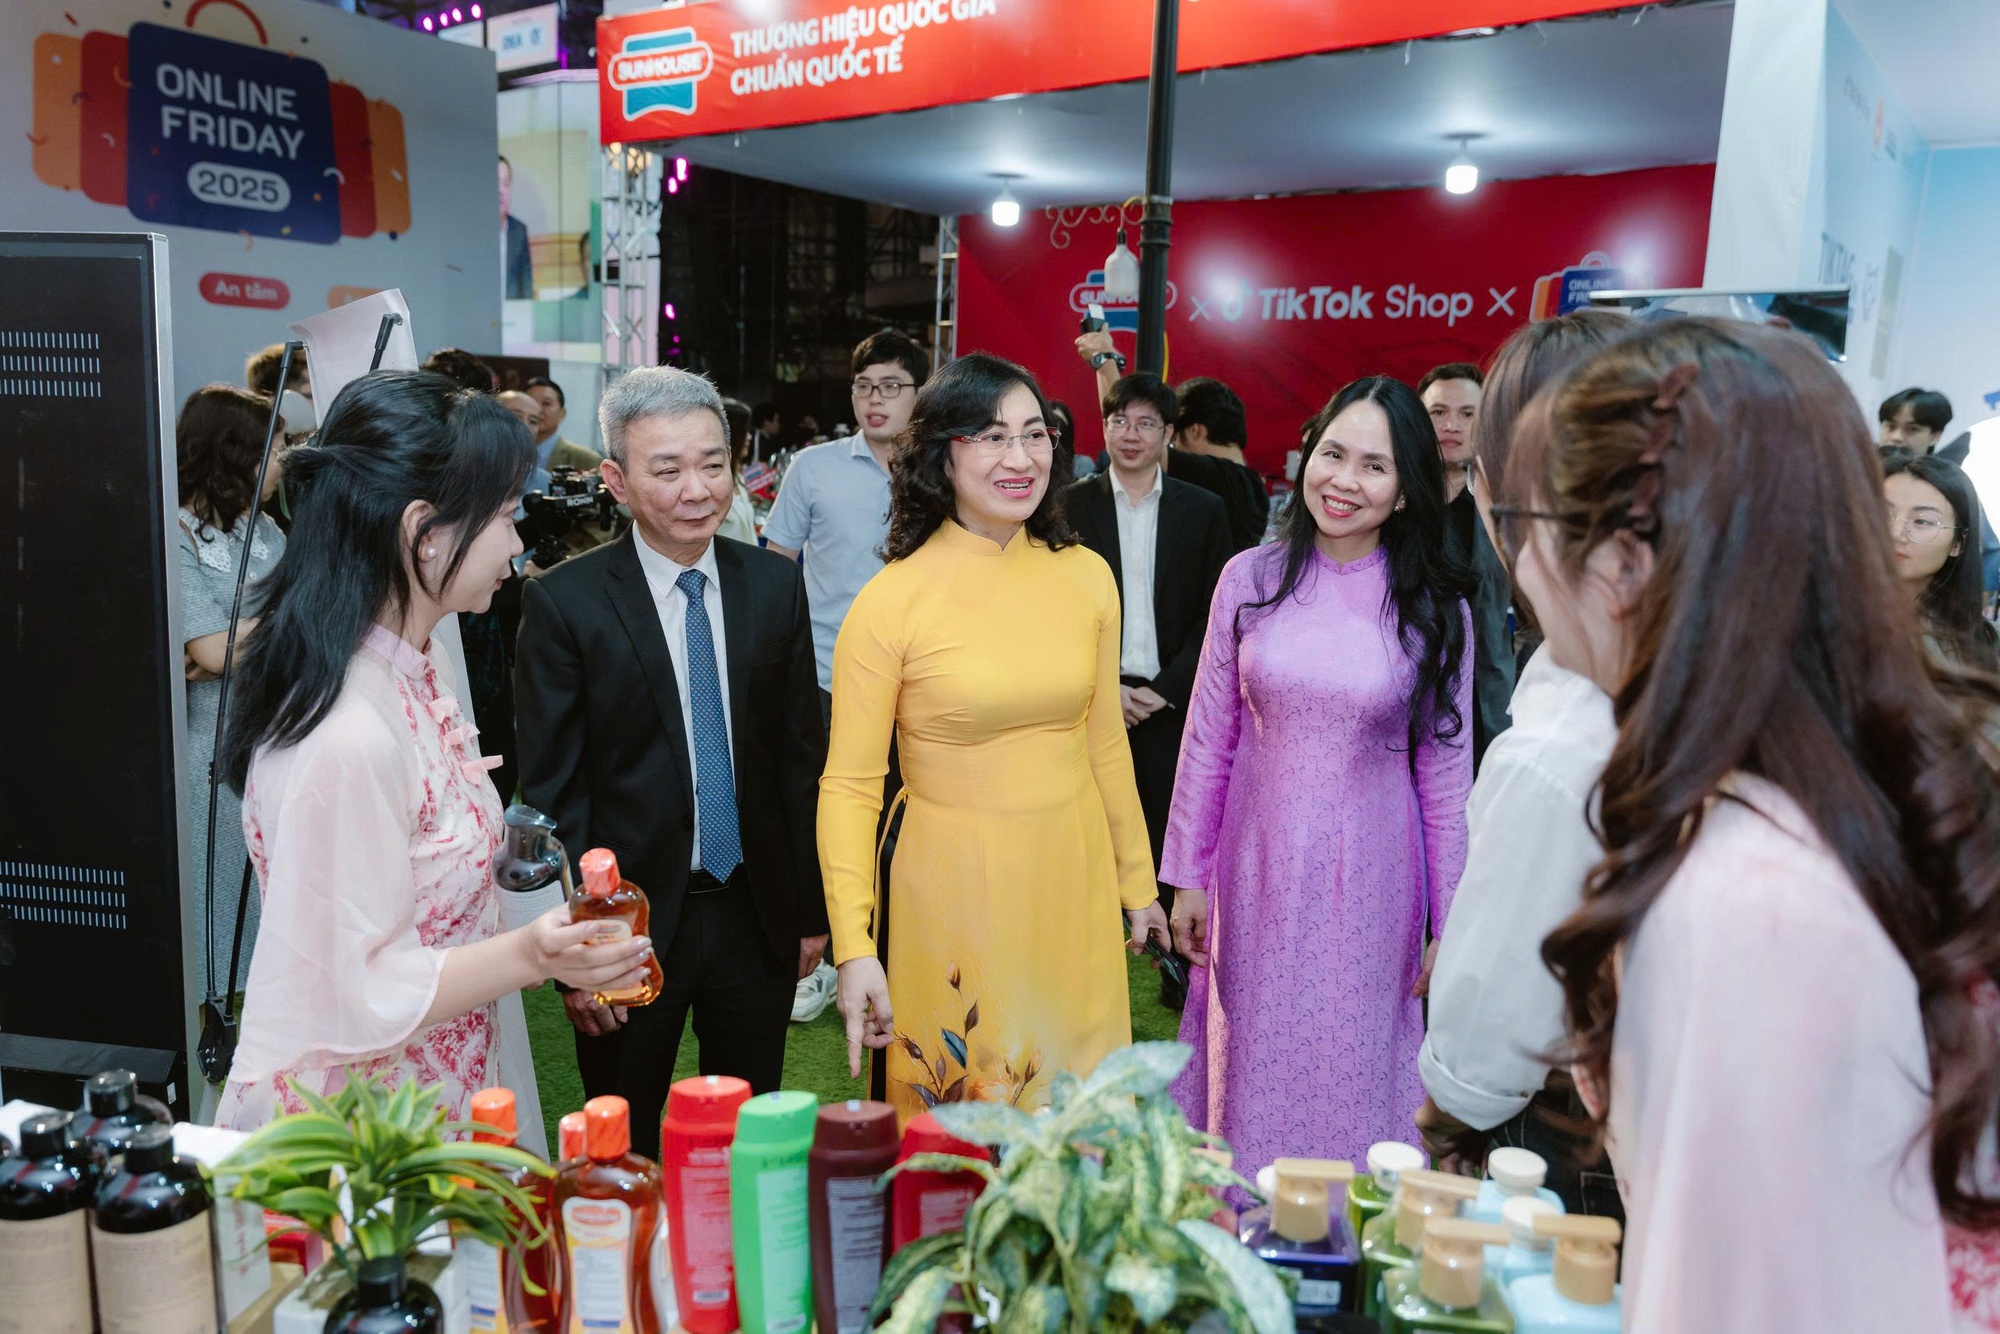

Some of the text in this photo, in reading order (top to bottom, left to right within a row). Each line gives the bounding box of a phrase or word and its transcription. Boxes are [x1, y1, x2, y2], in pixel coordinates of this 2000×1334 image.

[618, 50, 702, 81] SUNHOUSE
[873, 34, 904, 74] TẾ
[156, 63, 299, 121] ONLINE
[161, 104, 304, 161] FRIDAY
[198, 169, 279, 203] 2025
[215, 279, 241, 298] An
[1258, 284, 1374, 321] TikTok
[1384, 283, 1474, 327] Shop
[566, 496, 594, 507] RONIN
